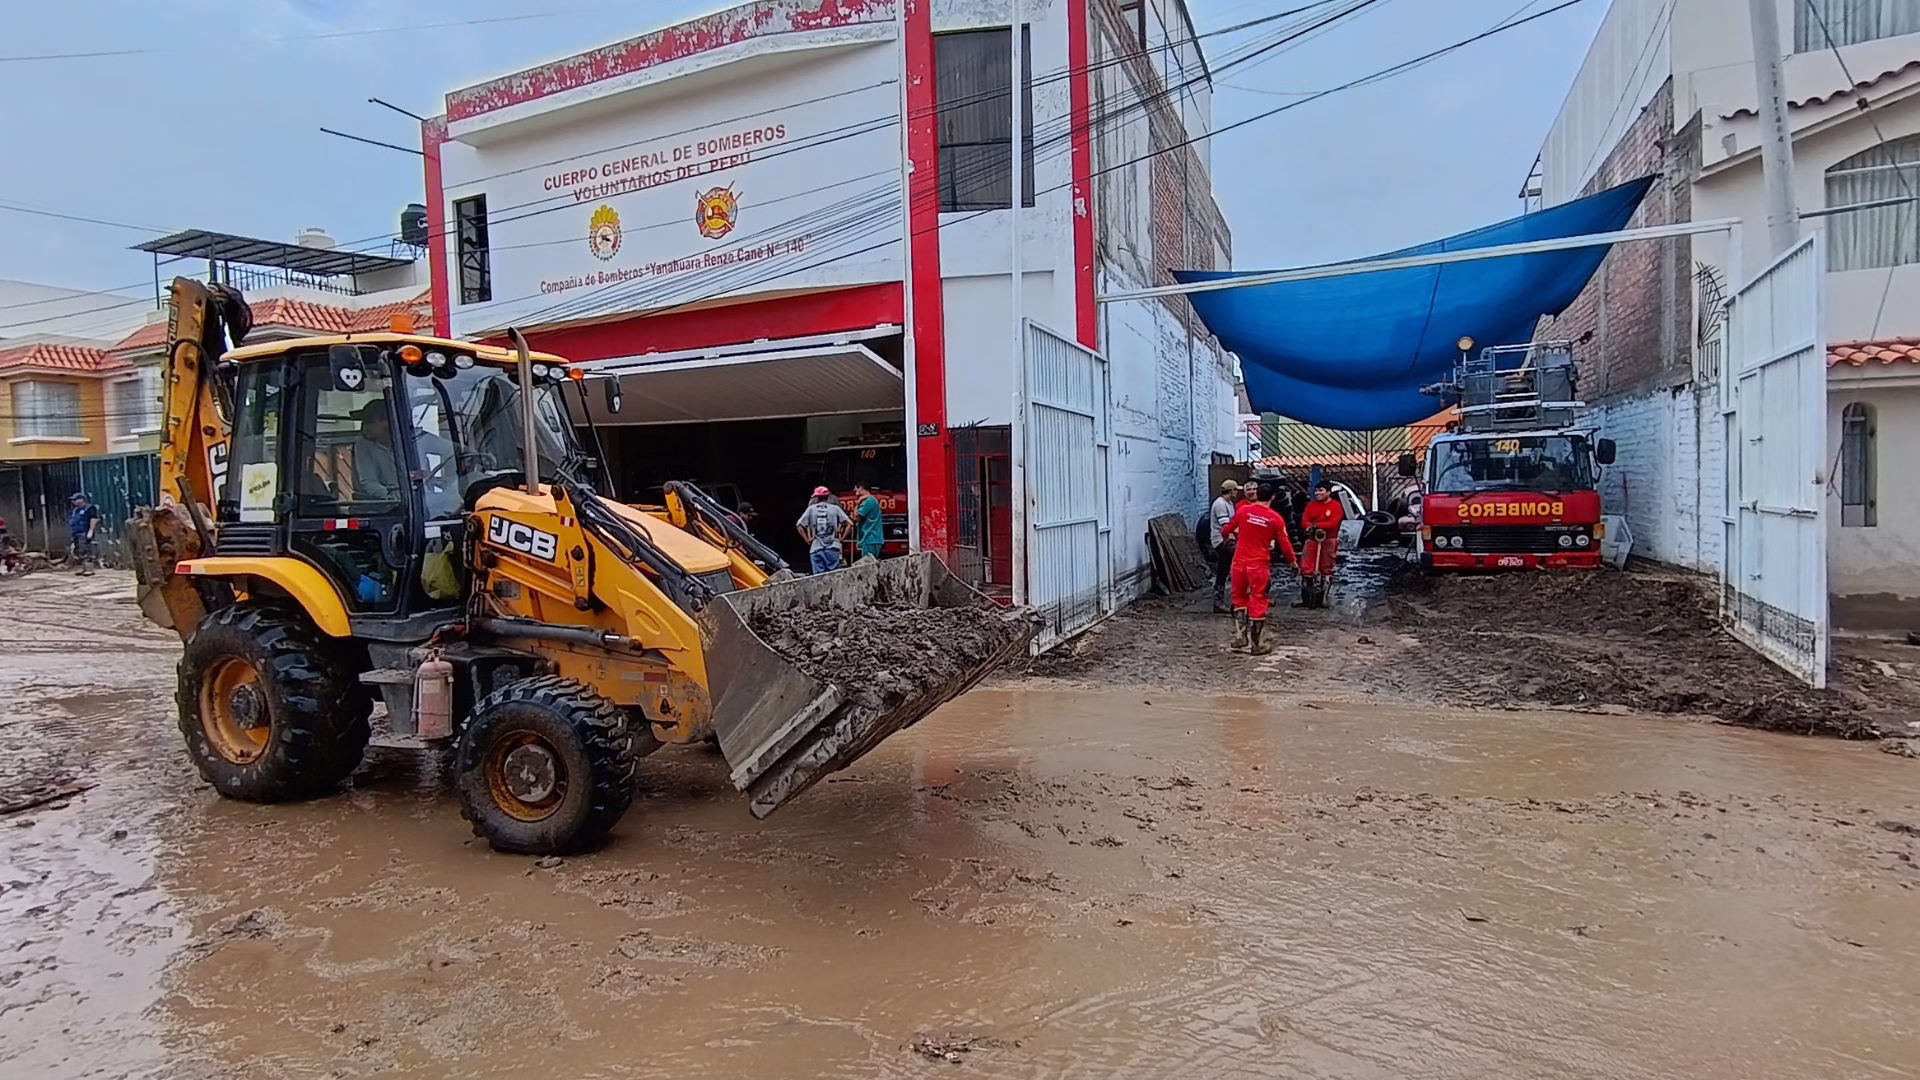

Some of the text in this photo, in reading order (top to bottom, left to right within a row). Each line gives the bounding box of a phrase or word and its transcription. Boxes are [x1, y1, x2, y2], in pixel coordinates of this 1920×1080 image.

[544, 124, 786, 191] CUERPO GENERAL DE BOMBEROS
[573, 169, 671, 201] VOLUNTARIOS
[677, 163, 701, 180] DEL
[585, 273, 596, 286] de
[598, 268, 643, 284] Bomberos
[703, 251, 734, 268] Renzo
[861, 449, 876, 459] 140
[1495, 439, 1520, 452] 140
[490, 516, 556, 560] JCB
